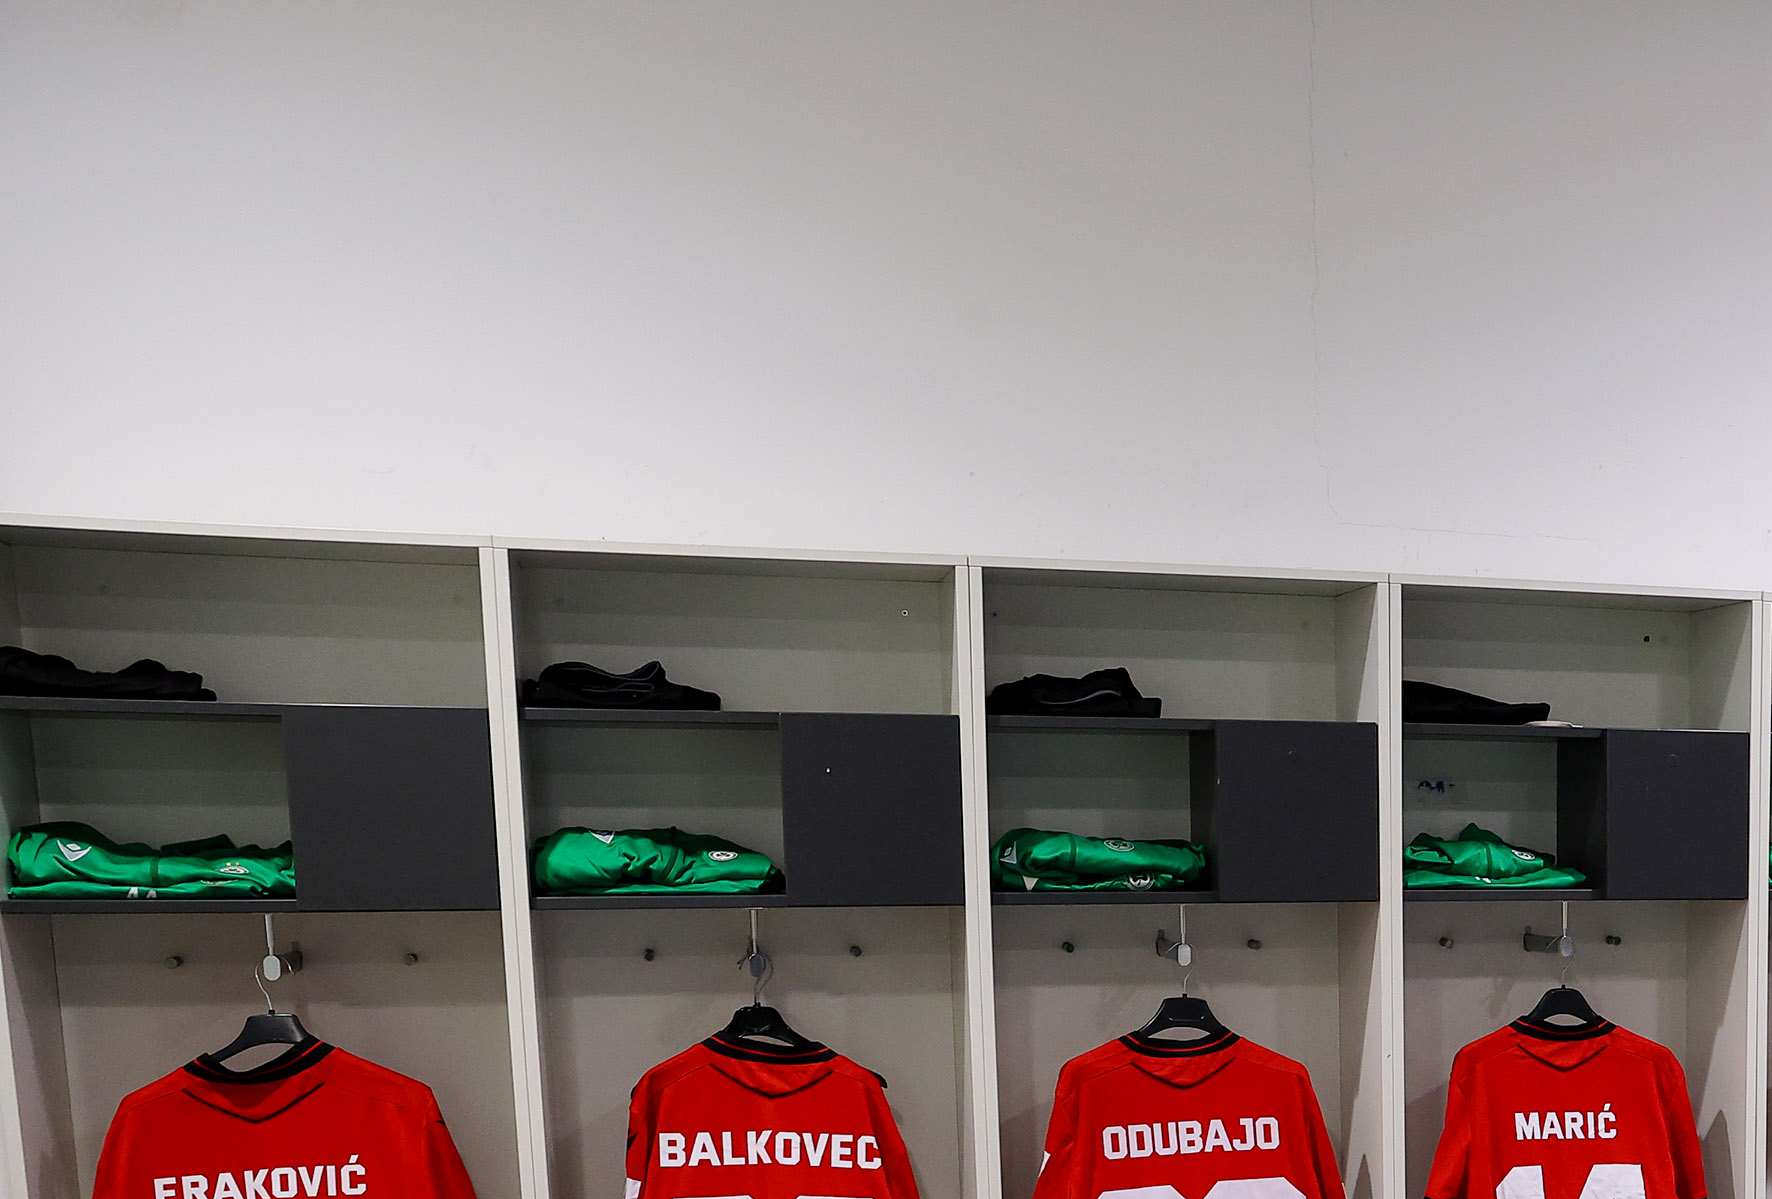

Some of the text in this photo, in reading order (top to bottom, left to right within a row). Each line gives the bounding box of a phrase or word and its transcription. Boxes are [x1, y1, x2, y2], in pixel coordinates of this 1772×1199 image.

[1103, 1117, 1279, 1159] ODUBAJO
[1515, 1104, 1616, 1140] MARIĆ
[659, 1130, 881, 1169] BALKOVEC
